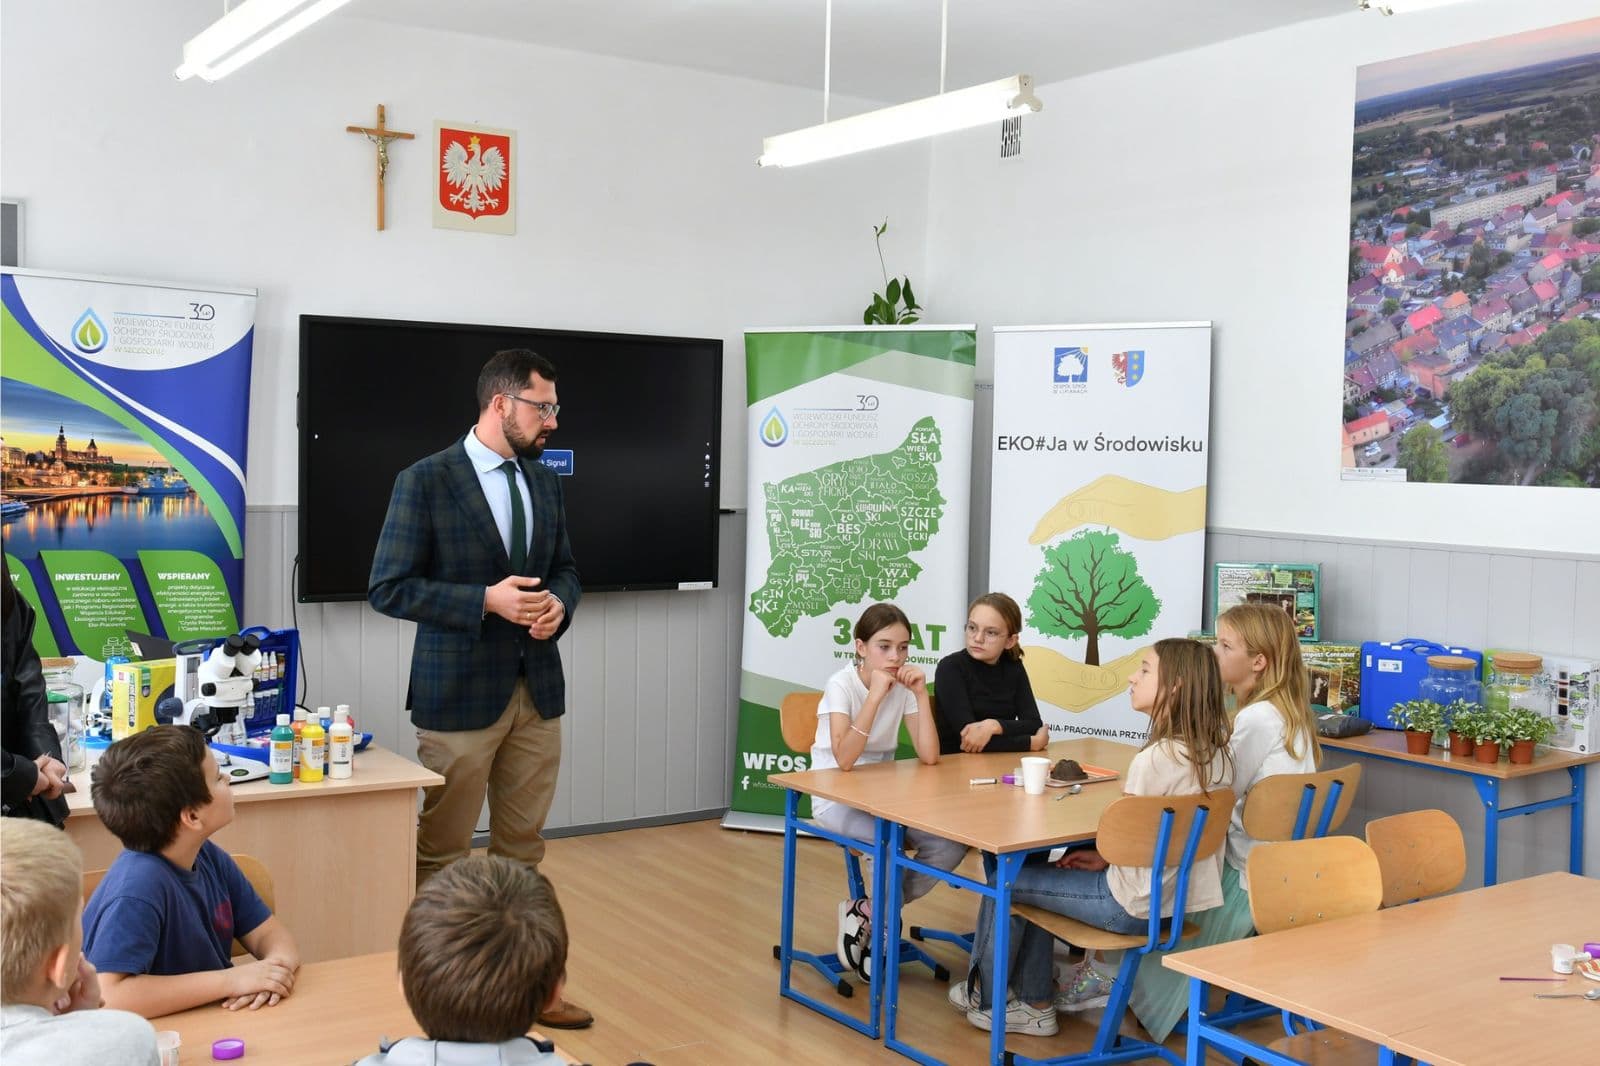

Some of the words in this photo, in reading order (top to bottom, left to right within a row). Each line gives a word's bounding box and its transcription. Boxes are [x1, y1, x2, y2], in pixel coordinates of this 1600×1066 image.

[911, 432, 938, 444] SŁA
[997, 435, 1068, 452] EKO#Ja
[1073, 438, 1089, 451] w
[1094, 431, 1204, 453] Środowisku
[918, 452, 937, 461] SKI
[841, 513, 854, 523] ŁO
[900, 507, 937, 519] SZCZE
[836, 523, 861, 534] BES
[902, 518, 929, 531] CIN
[908, 533, 928, 541] ECKI
[801, 549, 832, 557] STAR
[55, 573, 121, 581] INWESTUJEMY
[754, 599, 778, 614] SKI
[833, 617, 852, 646] 3
[1048, 724, 1118, 739] NIA-PRACOWNIA
